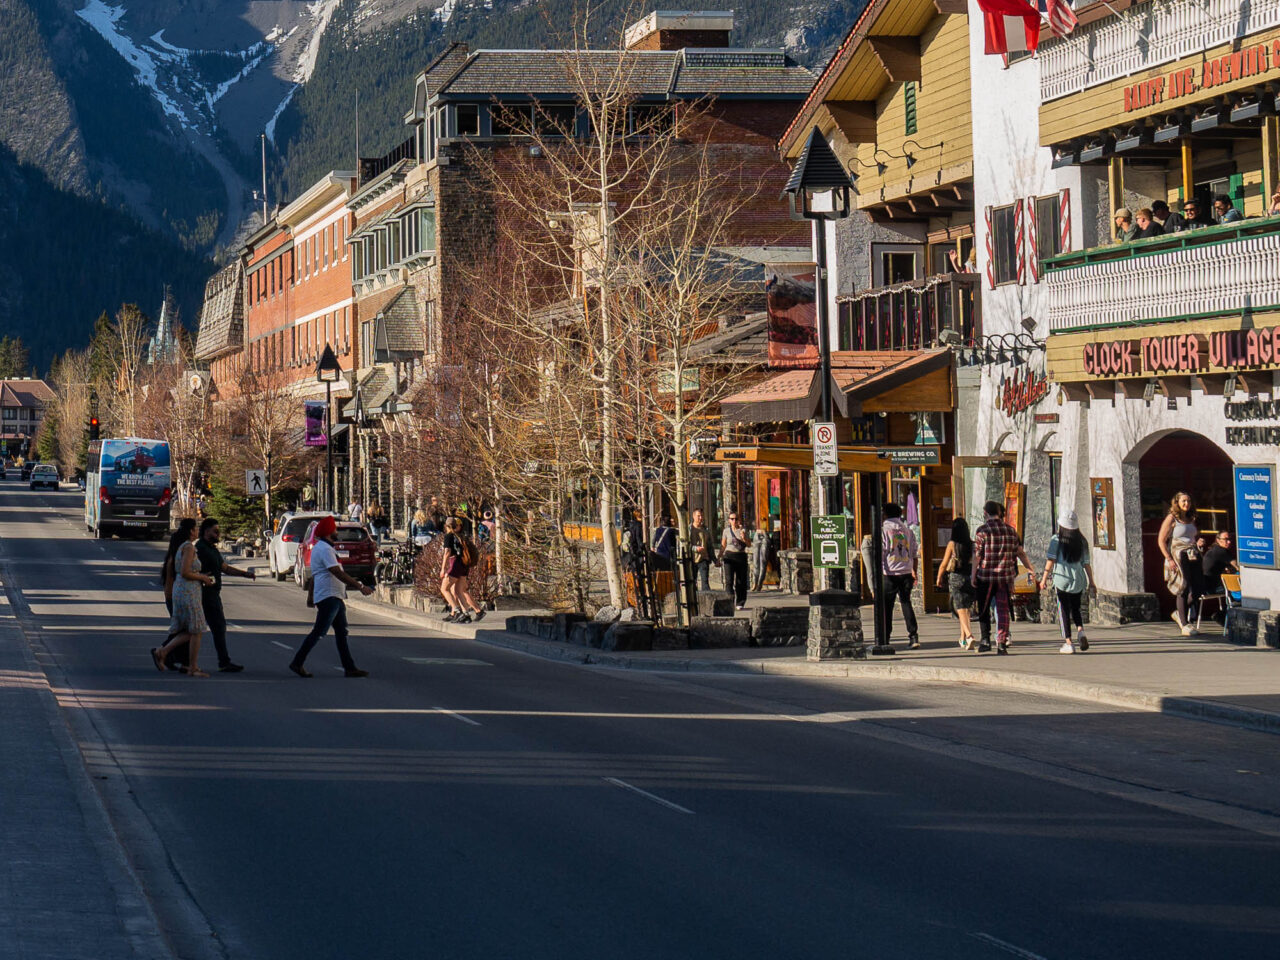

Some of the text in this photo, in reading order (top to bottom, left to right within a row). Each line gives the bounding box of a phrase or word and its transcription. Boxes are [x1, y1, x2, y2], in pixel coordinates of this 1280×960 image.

[1123, 77, 1164, 113] BANFF
[1202, 44, 1268, 89] BREWING
[1083, 325, 1280, 375] CLOCK TOWER VILLAGE
